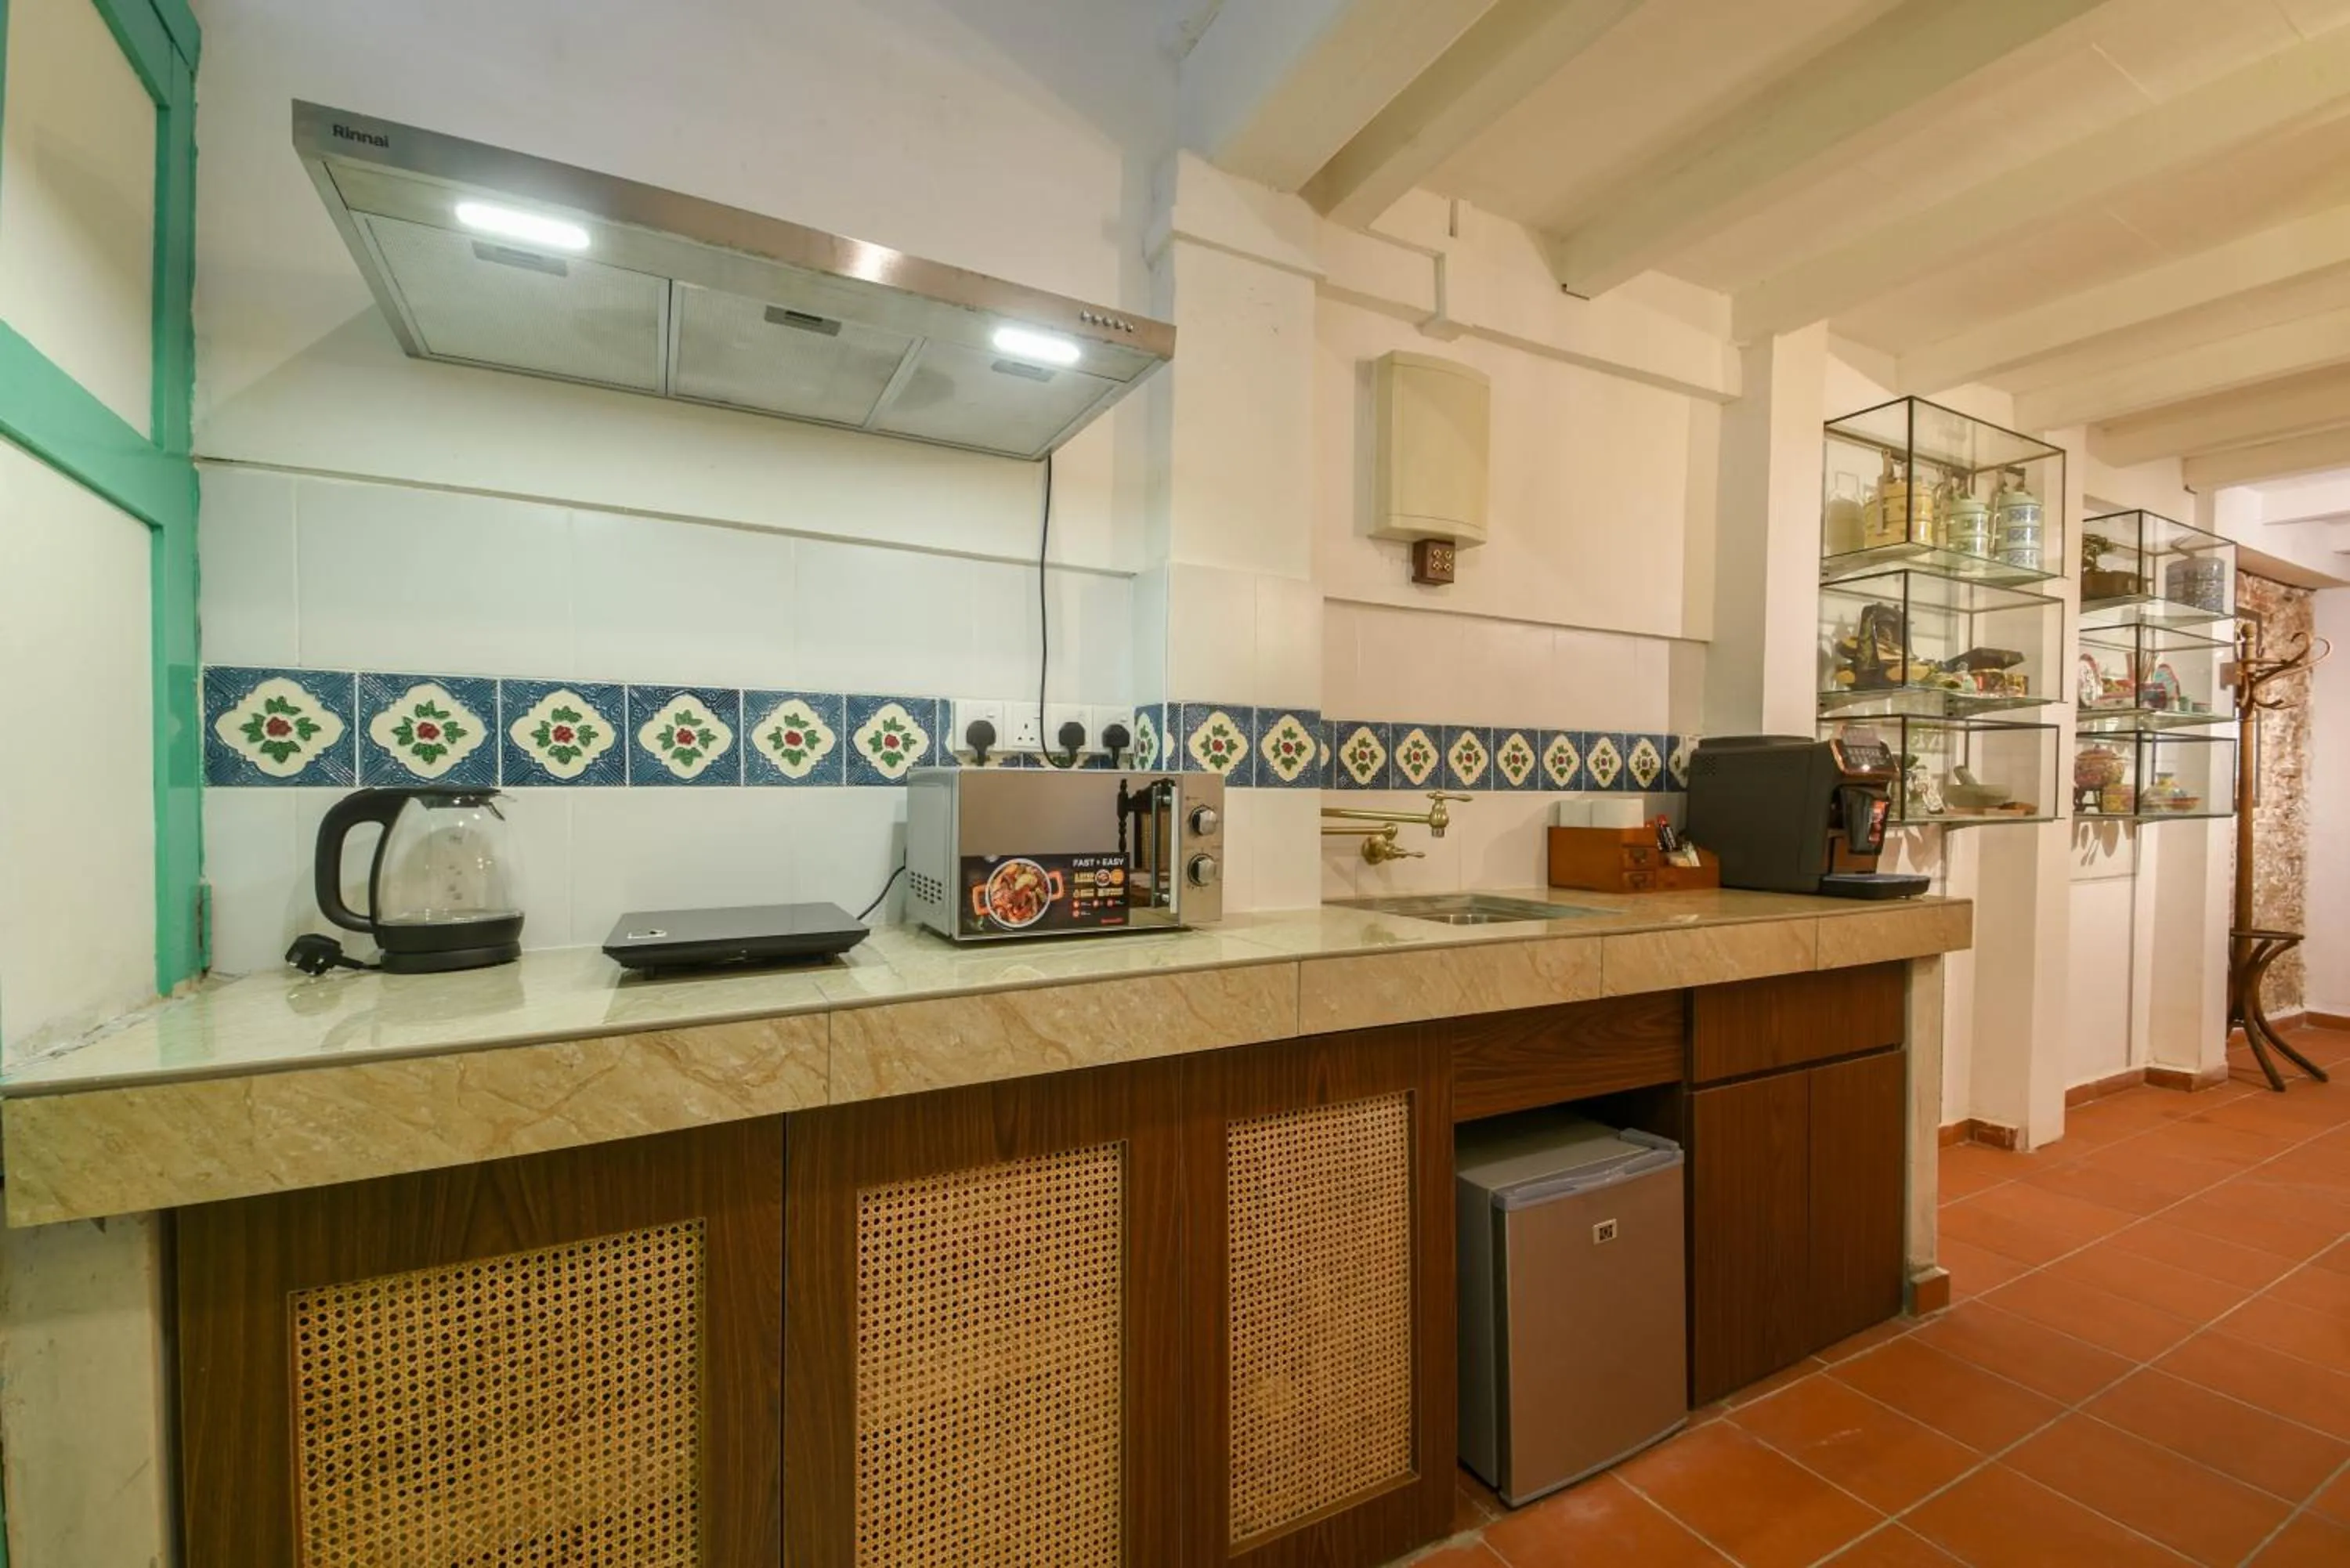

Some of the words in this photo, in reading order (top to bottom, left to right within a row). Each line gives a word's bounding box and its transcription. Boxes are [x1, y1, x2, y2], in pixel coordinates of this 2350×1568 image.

[332, 124, 390, 148] Rinnai
[1072, 858, 1094, 868] FAST
[1102, 857, 1124, 866] EASY
